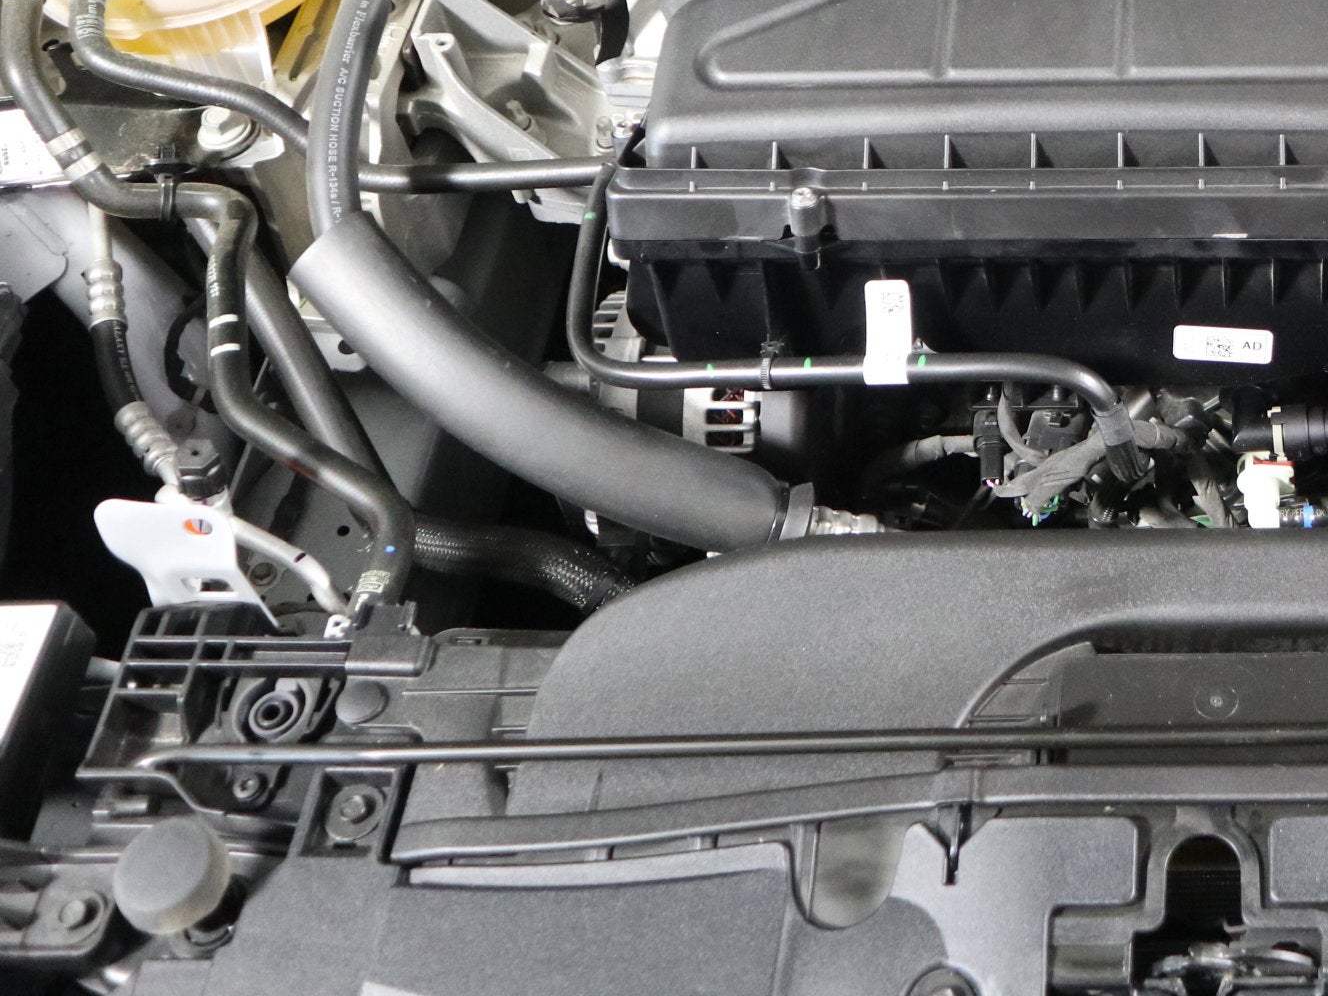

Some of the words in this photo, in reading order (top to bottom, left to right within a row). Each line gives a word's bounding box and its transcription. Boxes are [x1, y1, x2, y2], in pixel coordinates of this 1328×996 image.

[341, 9, 367, 64] Flexbarrier
[337, 67, 350, 85] A/C
[330, 86, 345, 131] SUCTION
[328, 134, 340, 163] HOSE
[328, 164, 339, 199] R-134a
[1242, 341, 1263, 351] AD
